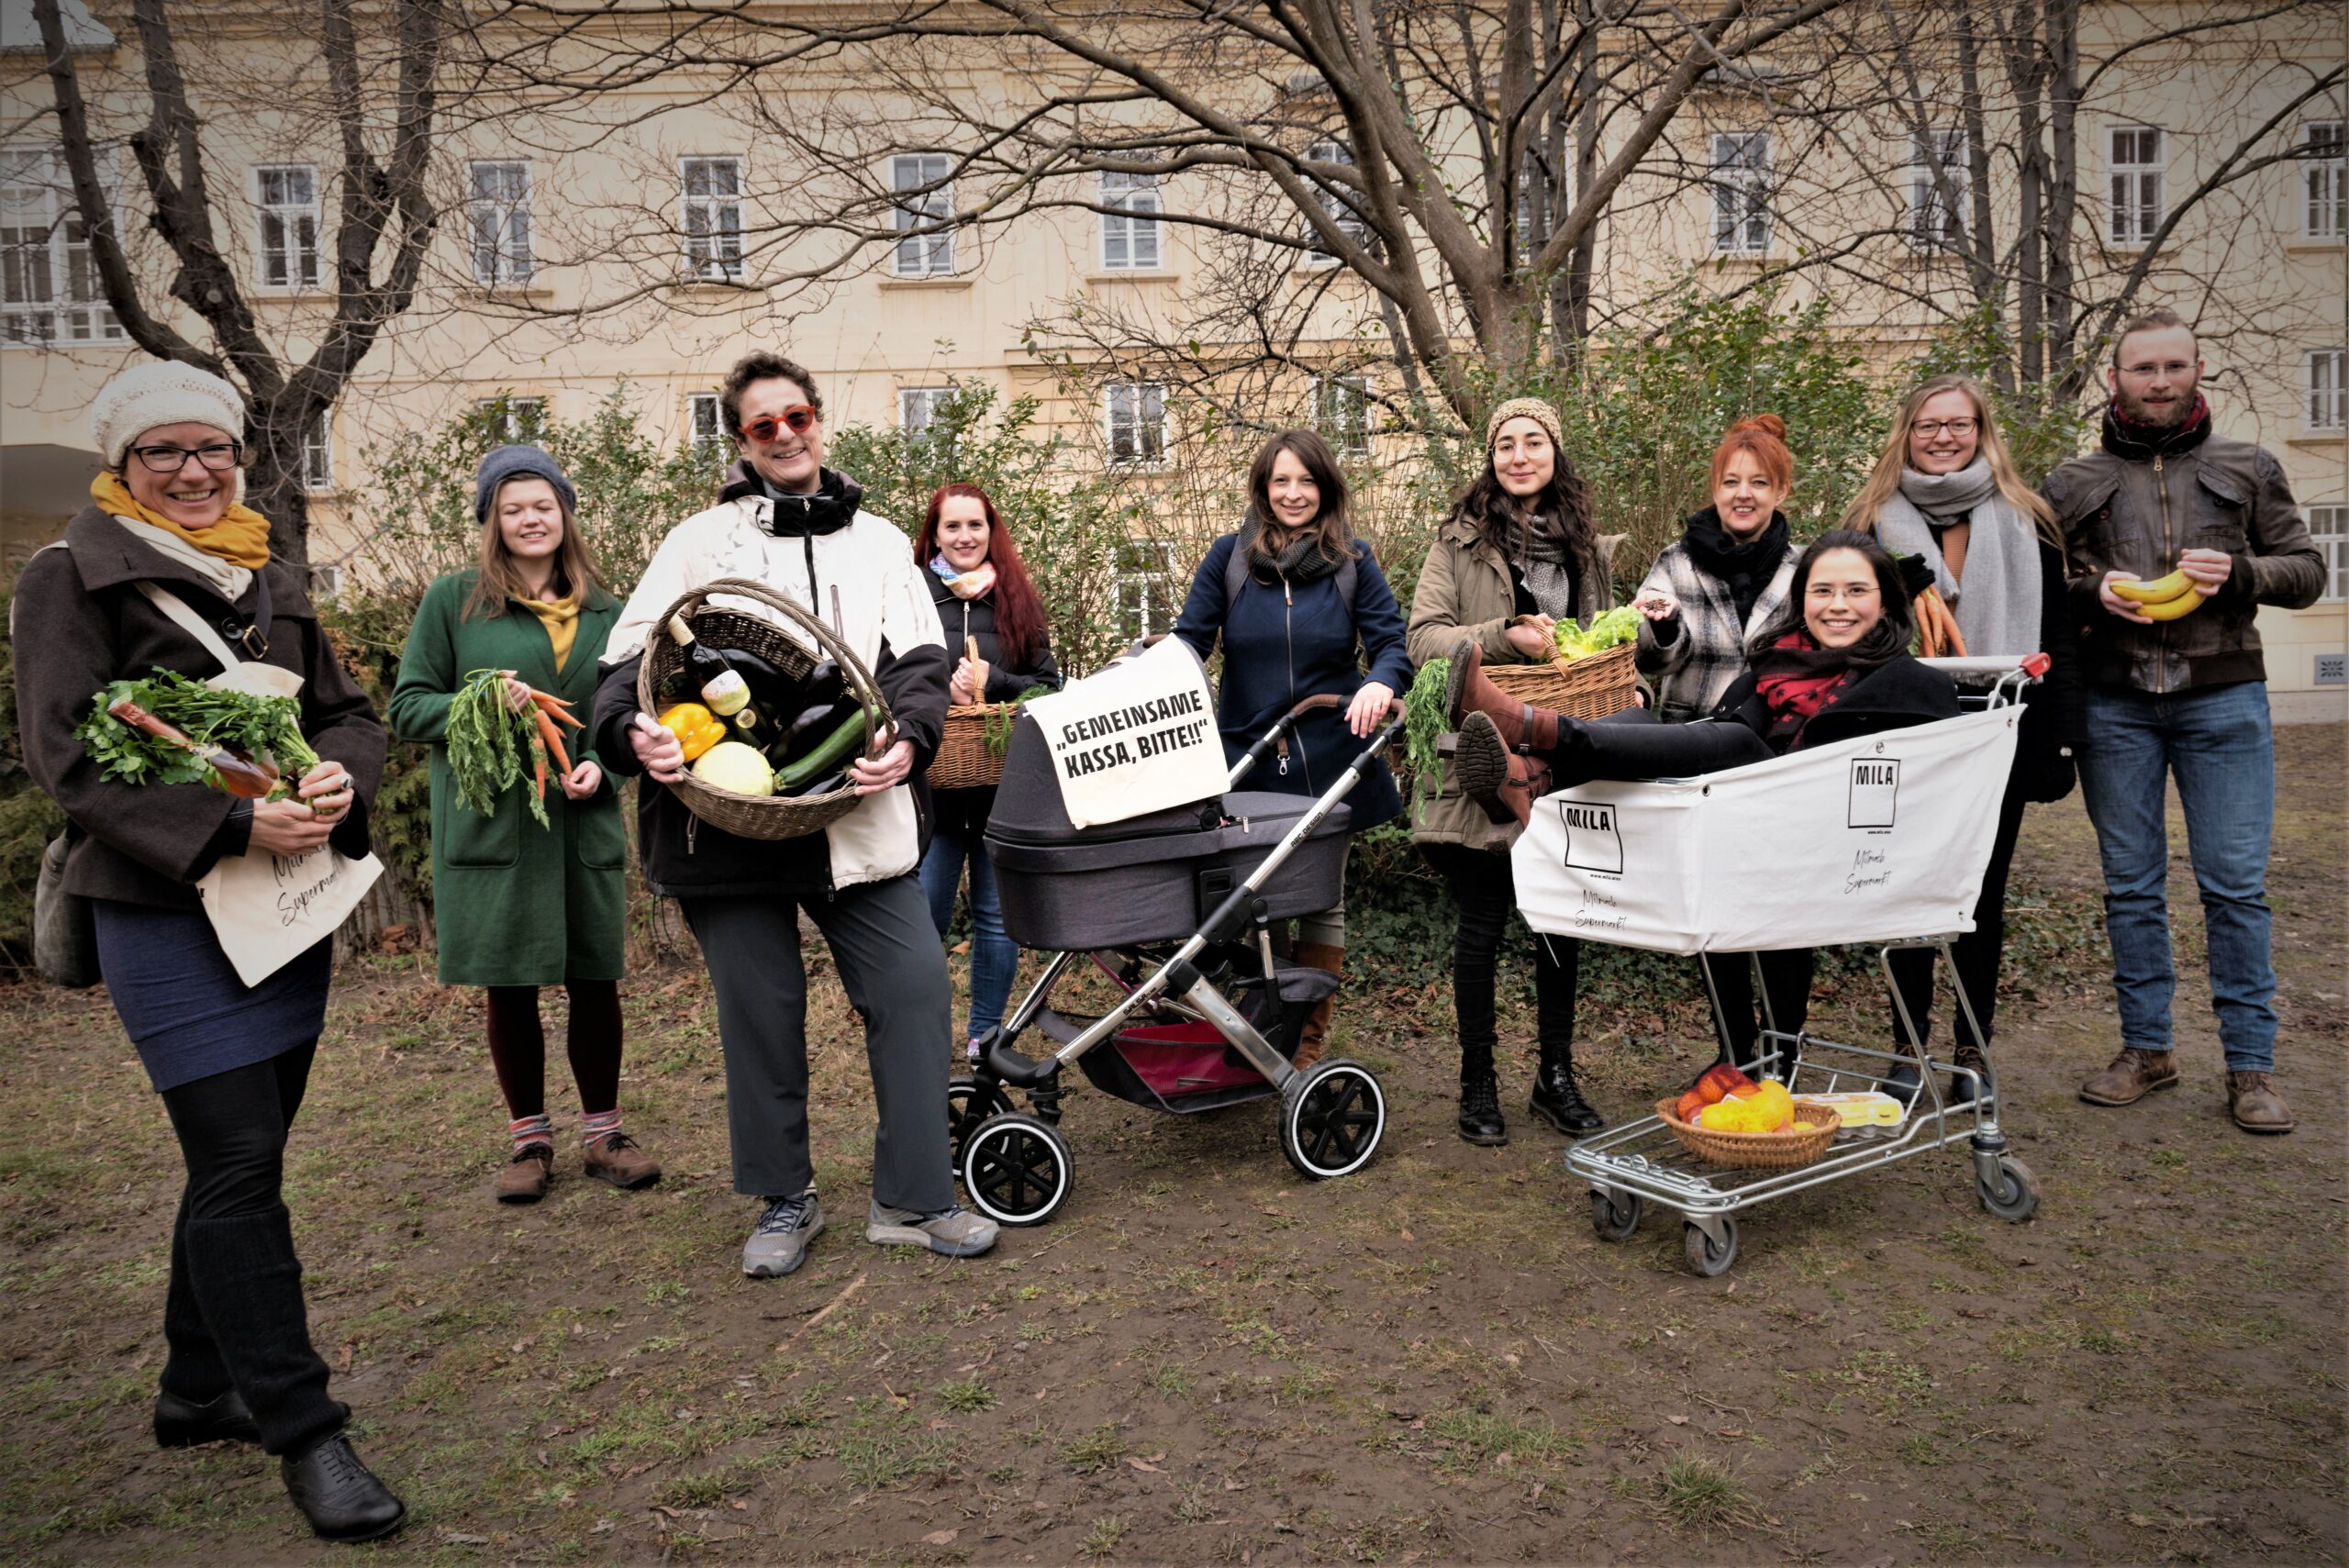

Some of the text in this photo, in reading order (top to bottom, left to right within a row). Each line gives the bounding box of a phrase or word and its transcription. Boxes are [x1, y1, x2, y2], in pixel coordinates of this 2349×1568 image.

[1064, 740, 1137, 779] KASSA,
[1855, 765, 1893, 785] MILA
[1566, 808, 1611, 831] MILA
[1290, 833, 1303, 848] ABC
